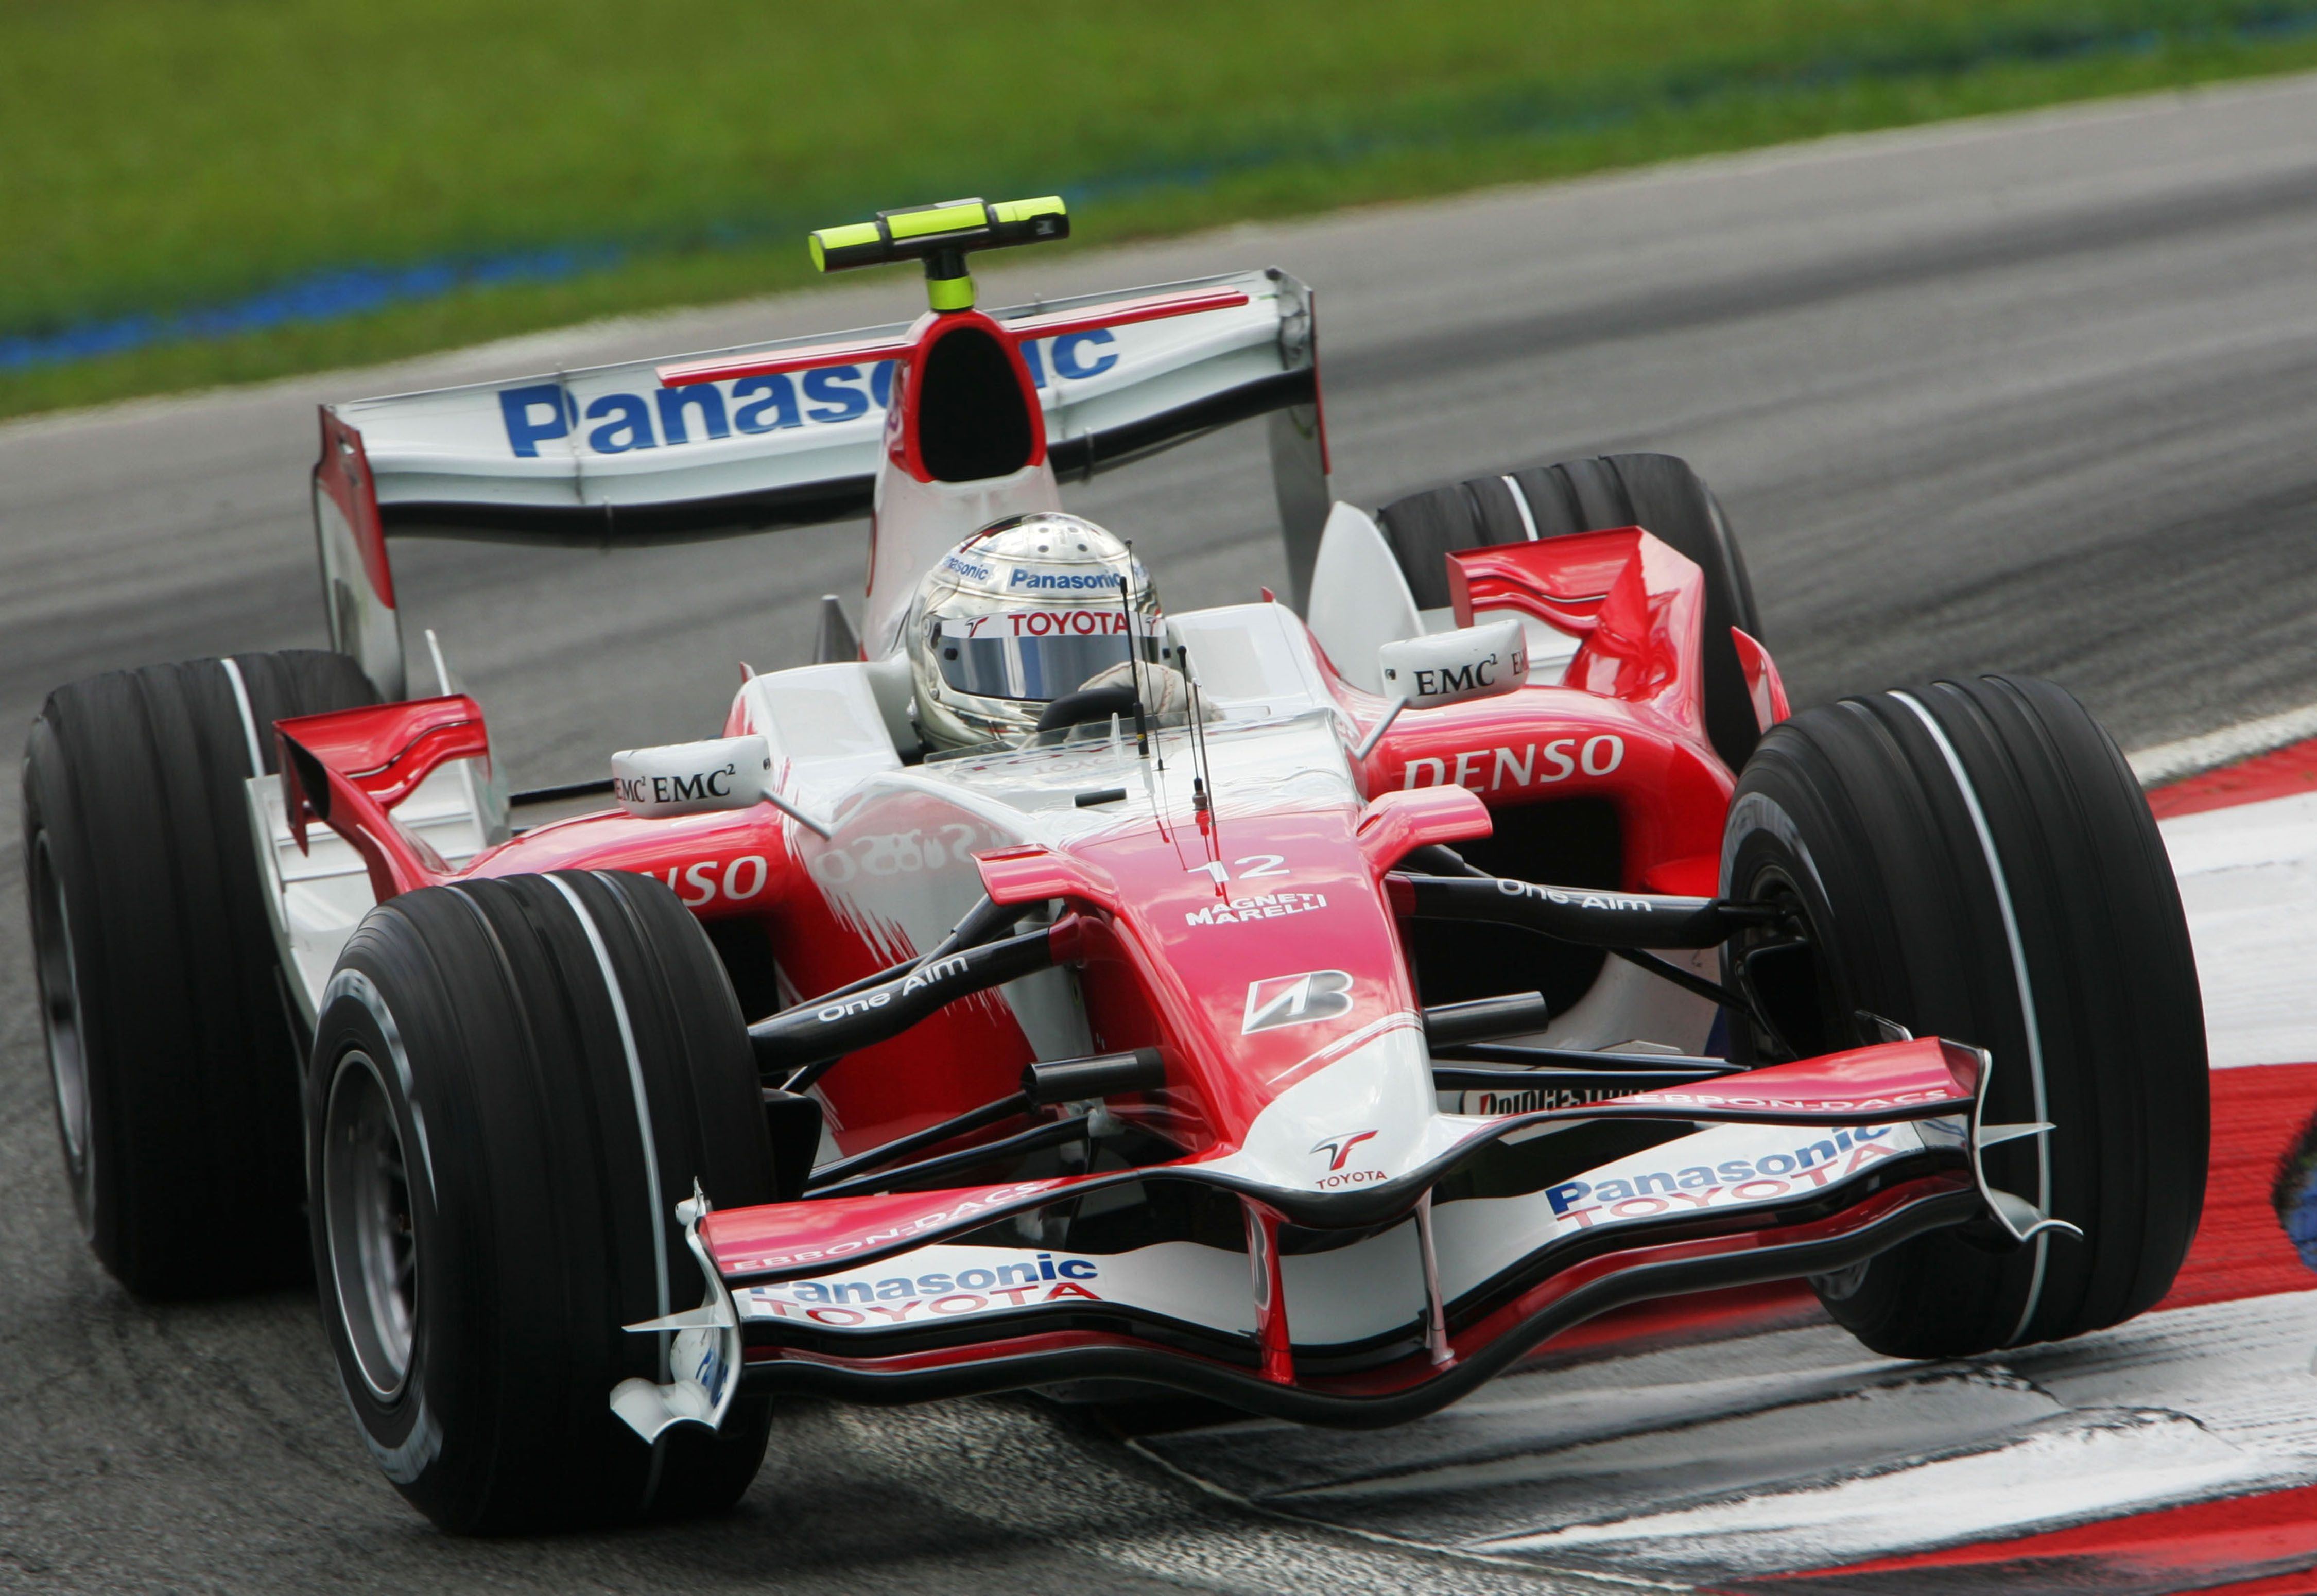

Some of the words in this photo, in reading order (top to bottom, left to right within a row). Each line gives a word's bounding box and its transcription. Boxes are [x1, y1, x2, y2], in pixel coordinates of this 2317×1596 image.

[1010, 568, 1121, 589] Panasonic
[1007, 611, 1128, 636] TOYOTA
[1404, 734, 1624, 793] DENSO
[1187, 854, 1290, 883] 12
[1192, 894, 1327, 918] MAGNETI
[1497, 879, 1569, 904] One
[1581, 896, 1652, 912] Aim
[1185, 901, 1327, 926] MARELLI
[818, 992, 891, 1022] One
[902, 957, 969, 997] Aim
[1315, 1170, 1388, 1190] TOYOTA
[1545, 1126, 1892, 1215] Panasonic
[1557, 1143, 1899, 1229] TOYOTA
[751, 1282, 1103, 1327] TOYOTA
